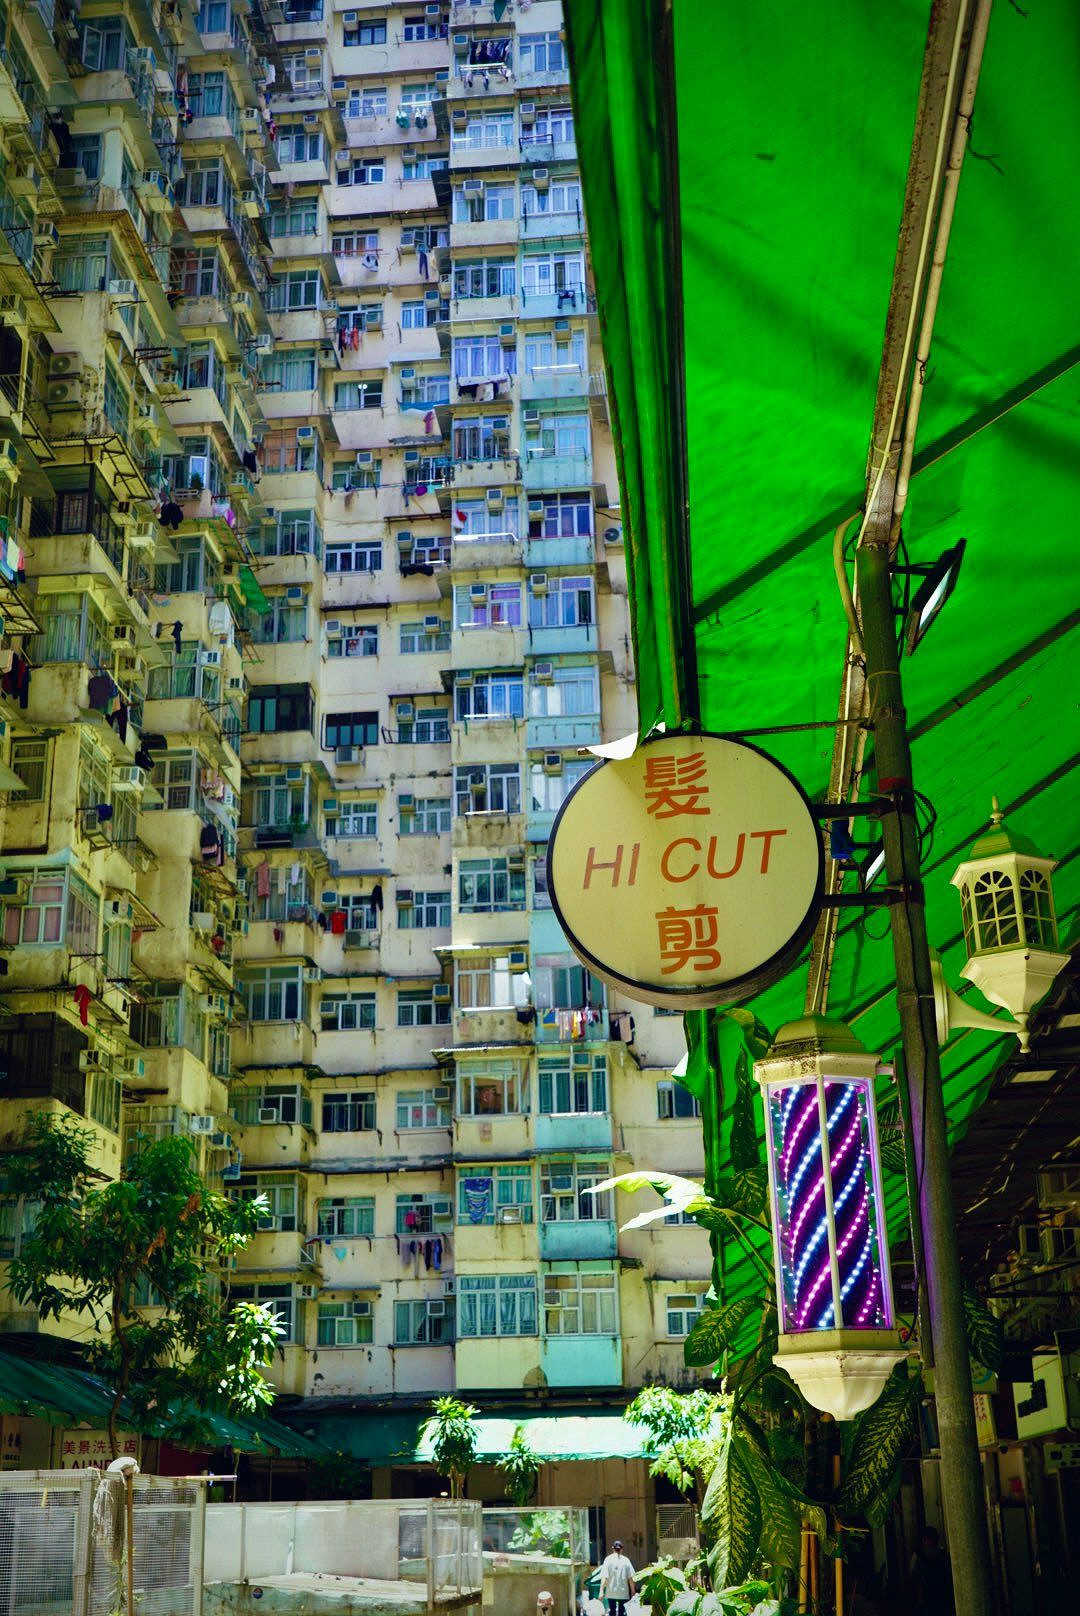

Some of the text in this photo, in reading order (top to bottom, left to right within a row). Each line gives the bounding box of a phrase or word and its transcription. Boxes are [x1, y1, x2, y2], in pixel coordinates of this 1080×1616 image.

[583, 829, 788, 890] HI CUT
[655, 903, 722, 975] 剪
[64, 1439, 137, 1454] 美景洗衣店
